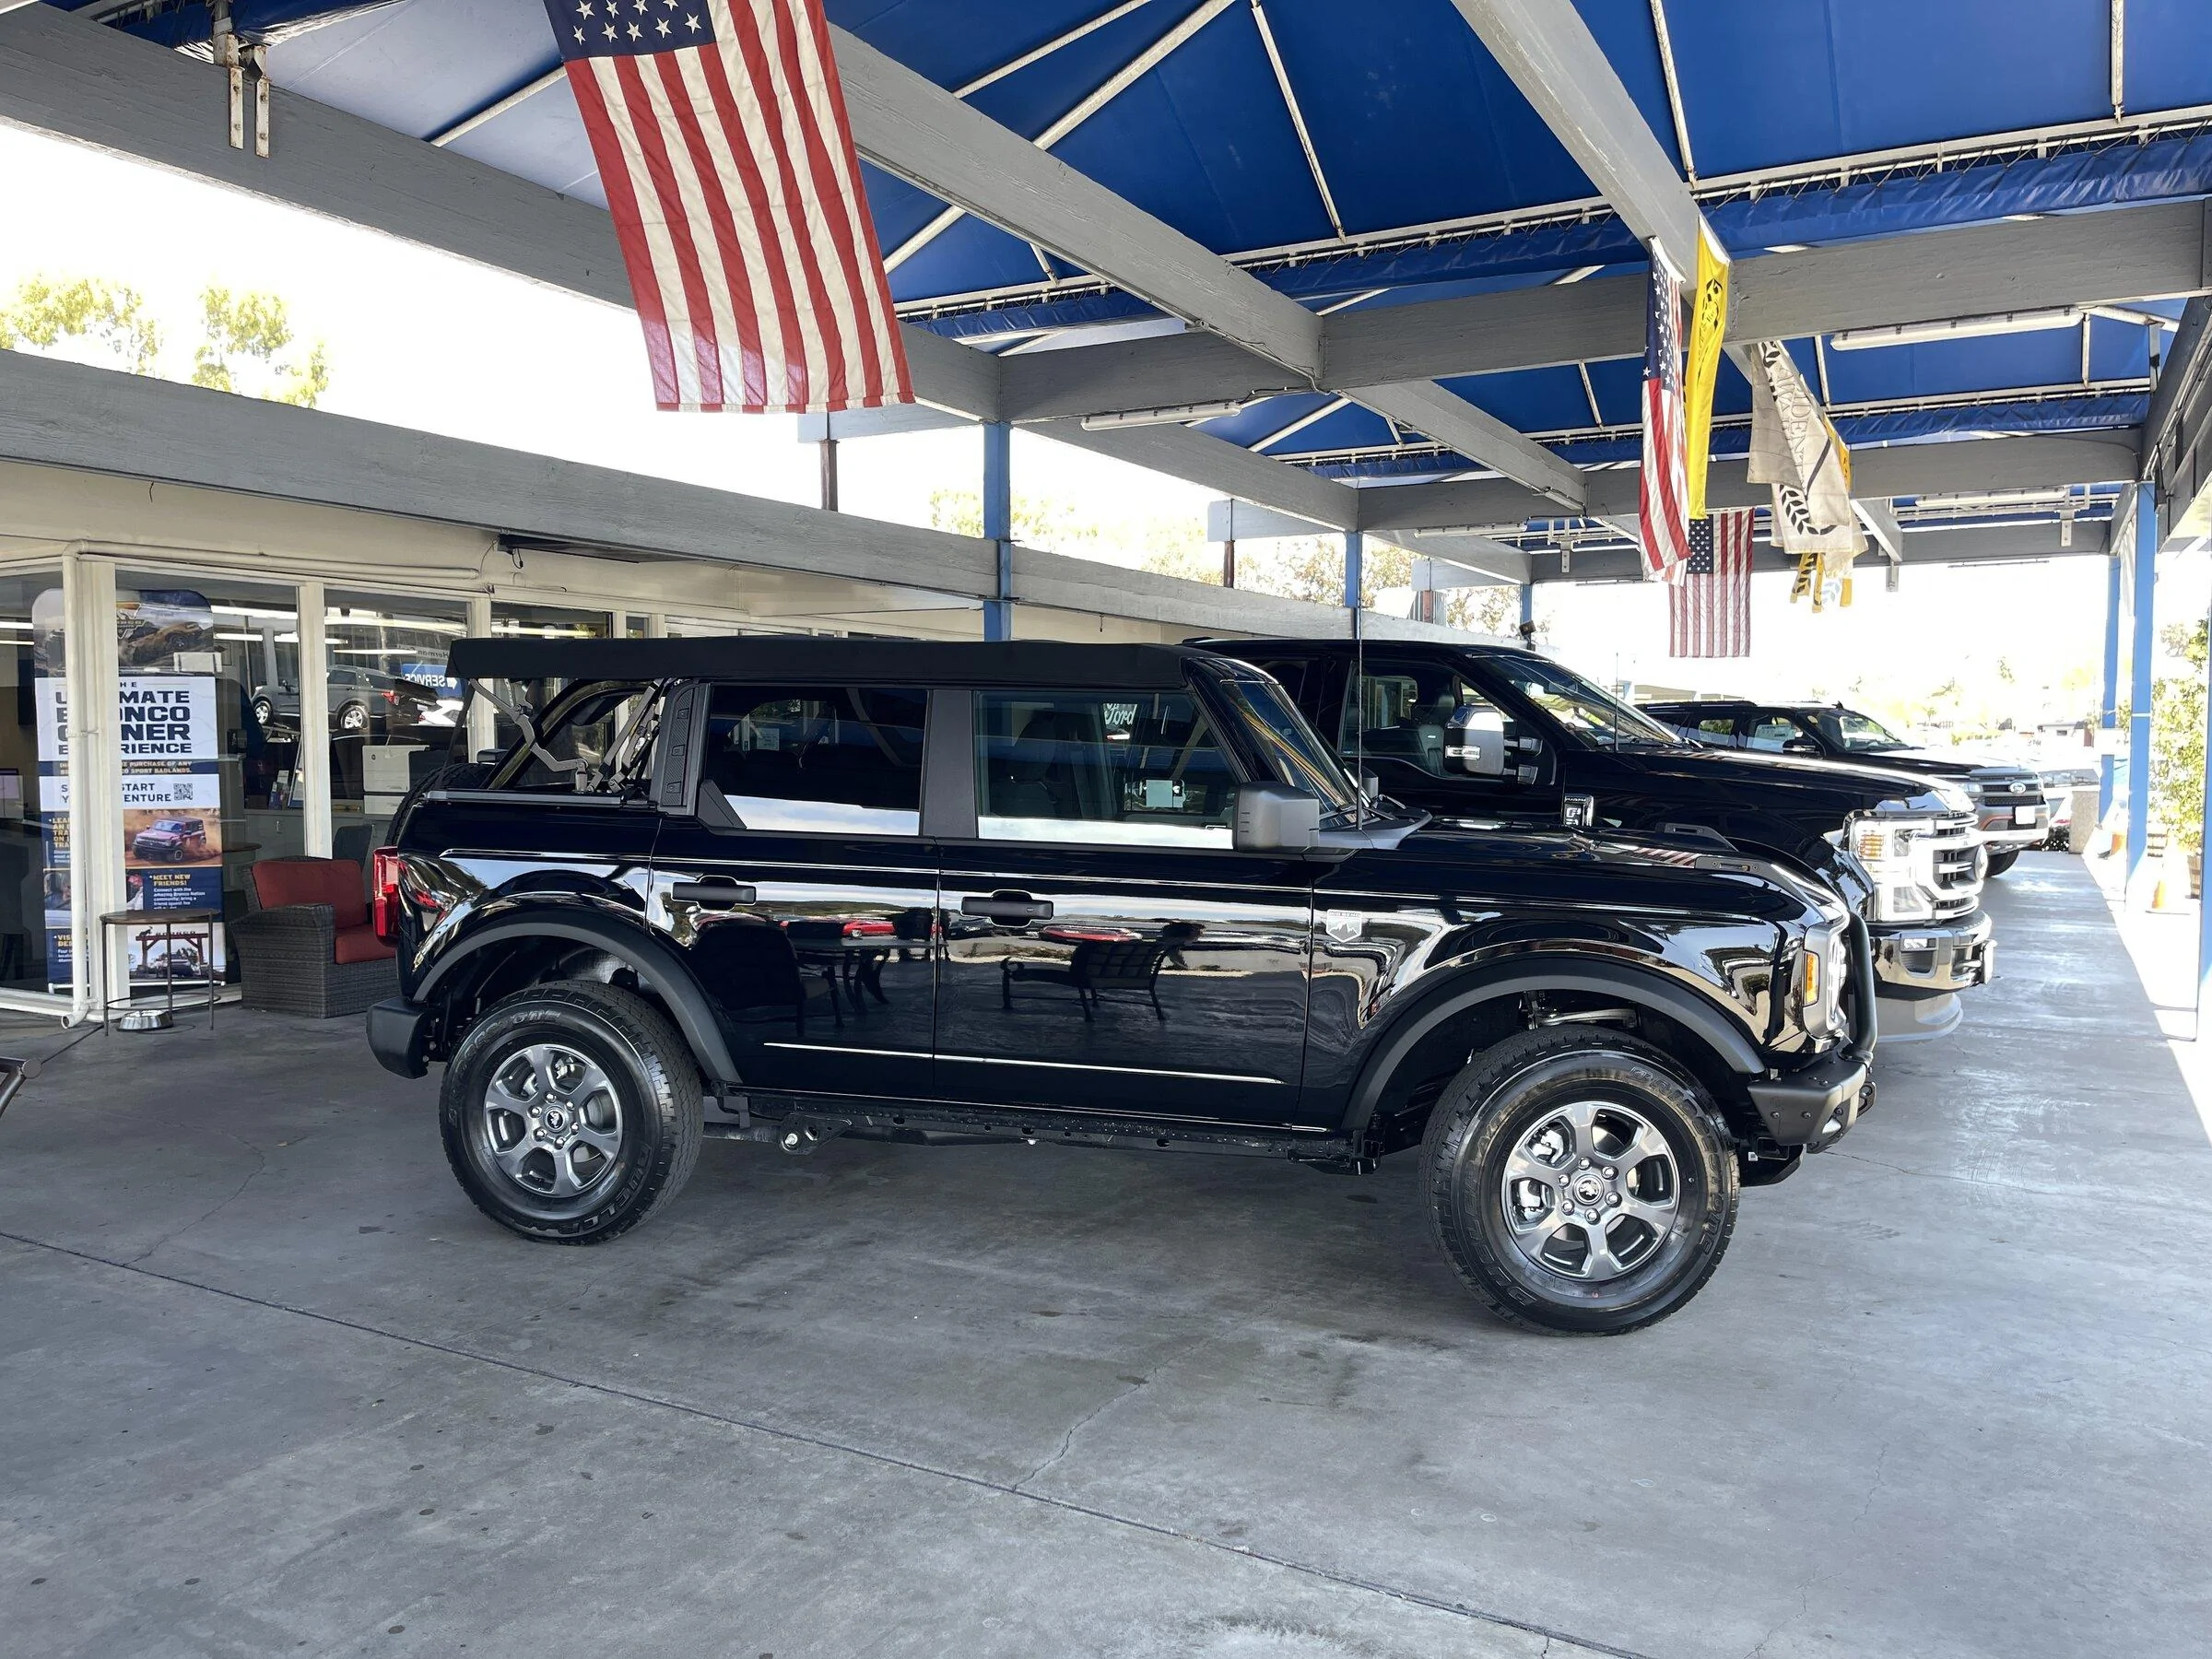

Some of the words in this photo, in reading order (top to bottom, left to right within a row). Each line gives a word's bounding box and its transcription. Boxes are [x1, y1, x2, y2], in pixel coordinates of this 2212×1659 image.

[55, 691, 190, 704] UMATE
[56, 706, 191, 723] BNCO
[57, 724, 192, 742] ONER
[59, 743, 192, 755] ERIENCE
[124, 794, 171, 803] ENTURE
